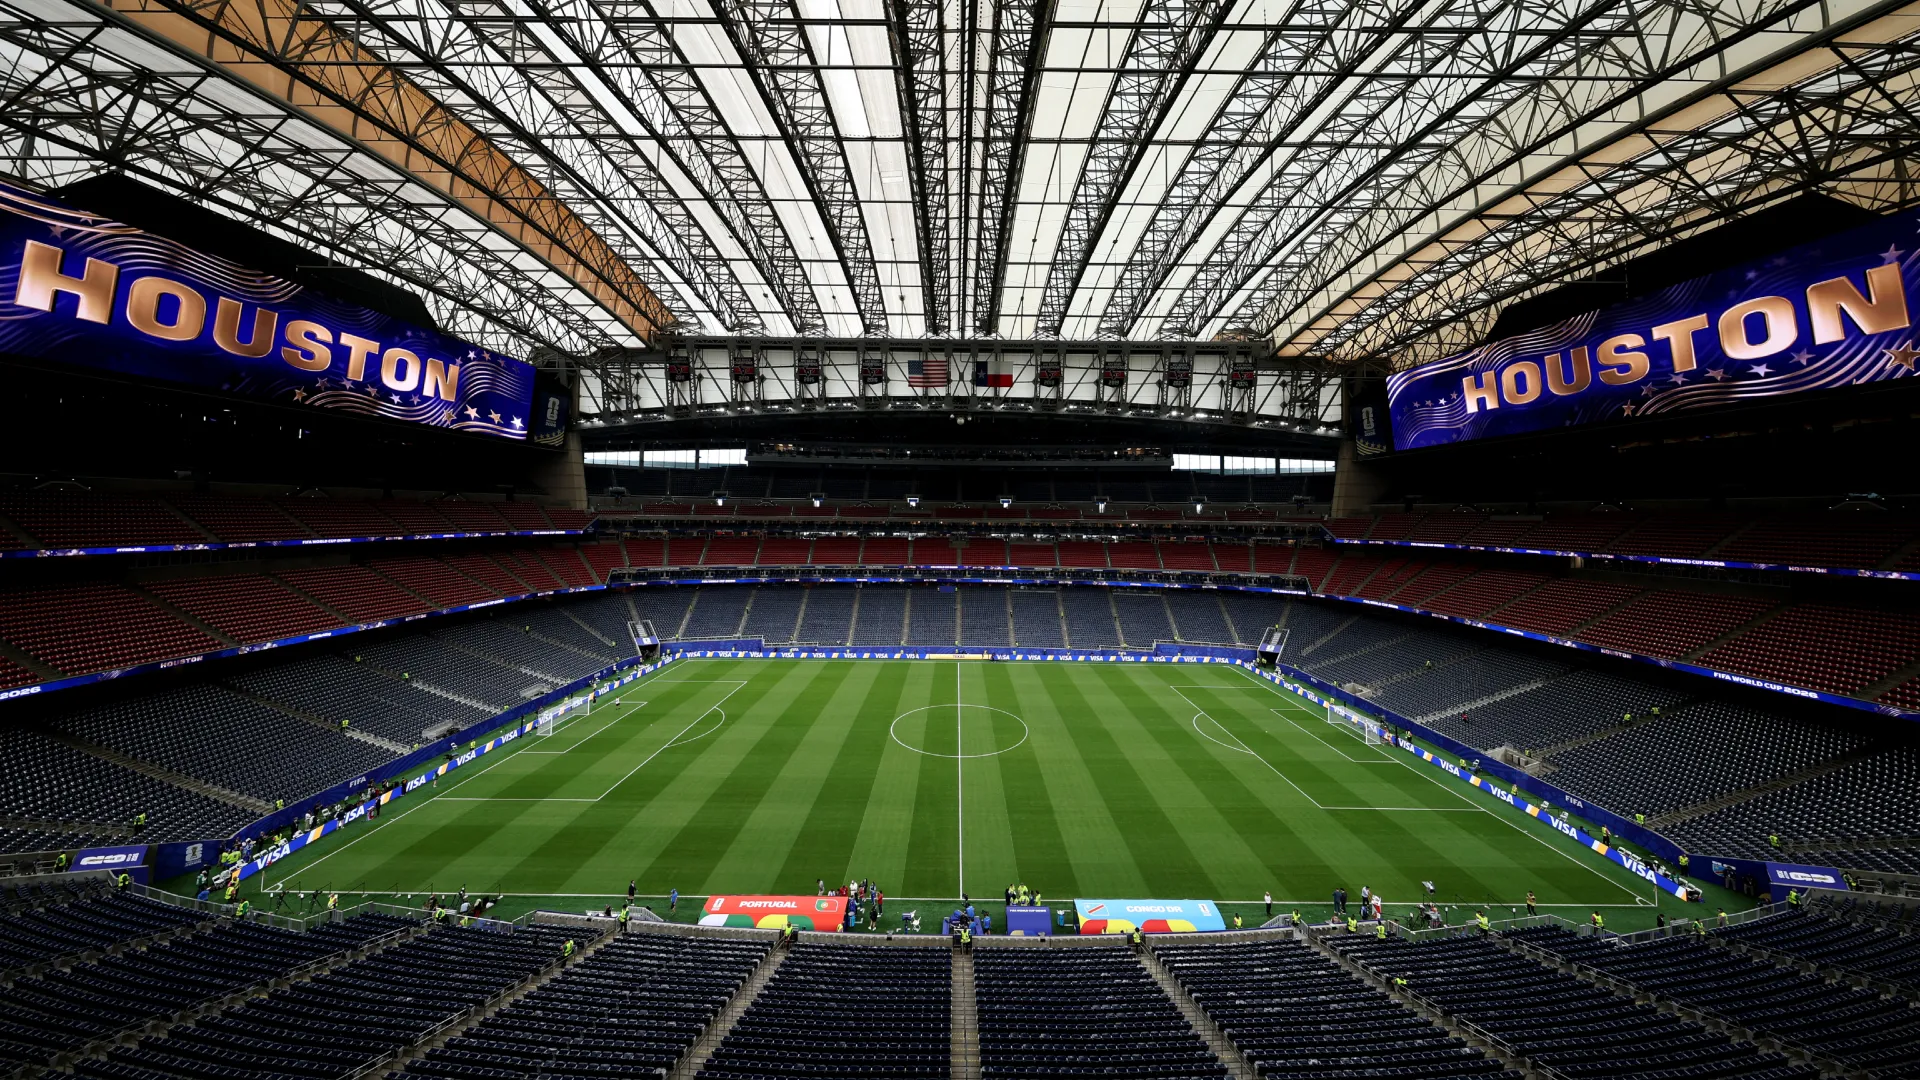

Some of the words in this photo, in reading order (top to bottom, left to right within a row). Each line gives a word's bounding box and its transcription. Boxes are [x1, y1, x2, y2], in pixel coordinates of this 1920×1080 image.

[15, 239, 460, 402] HOUSTON
[1462, 261, 1910, 414] HOUSTON
[160, 656, 203, 668] HOUSTON
[0, 686, 41, 700] 2026
[1714, 672, 1731, 681] FIFA
[1732, 675, 1763, 687] WORLD
[1764, 682, 1782, 691] CUP
[1784, 686, 1819, 698] 2026
[1307, 692, 1318, 704] VISA
[502, 730, 518, 743] VISA
[1398, 738, 1415, 754] VISA
[456, 750, 476, 767] VISA
[1440, 758, 1460, 777] VISA
[349, 776, 366, 788] FIFA
[1489, 783, 1514, 805] VISA
[1565, 794, 1583, 808] FIFA
[1548, 814, 1578, 840] VISA
[257, 843, 290, 869] VISA
[1619, 854, 1657, 884] VISA
